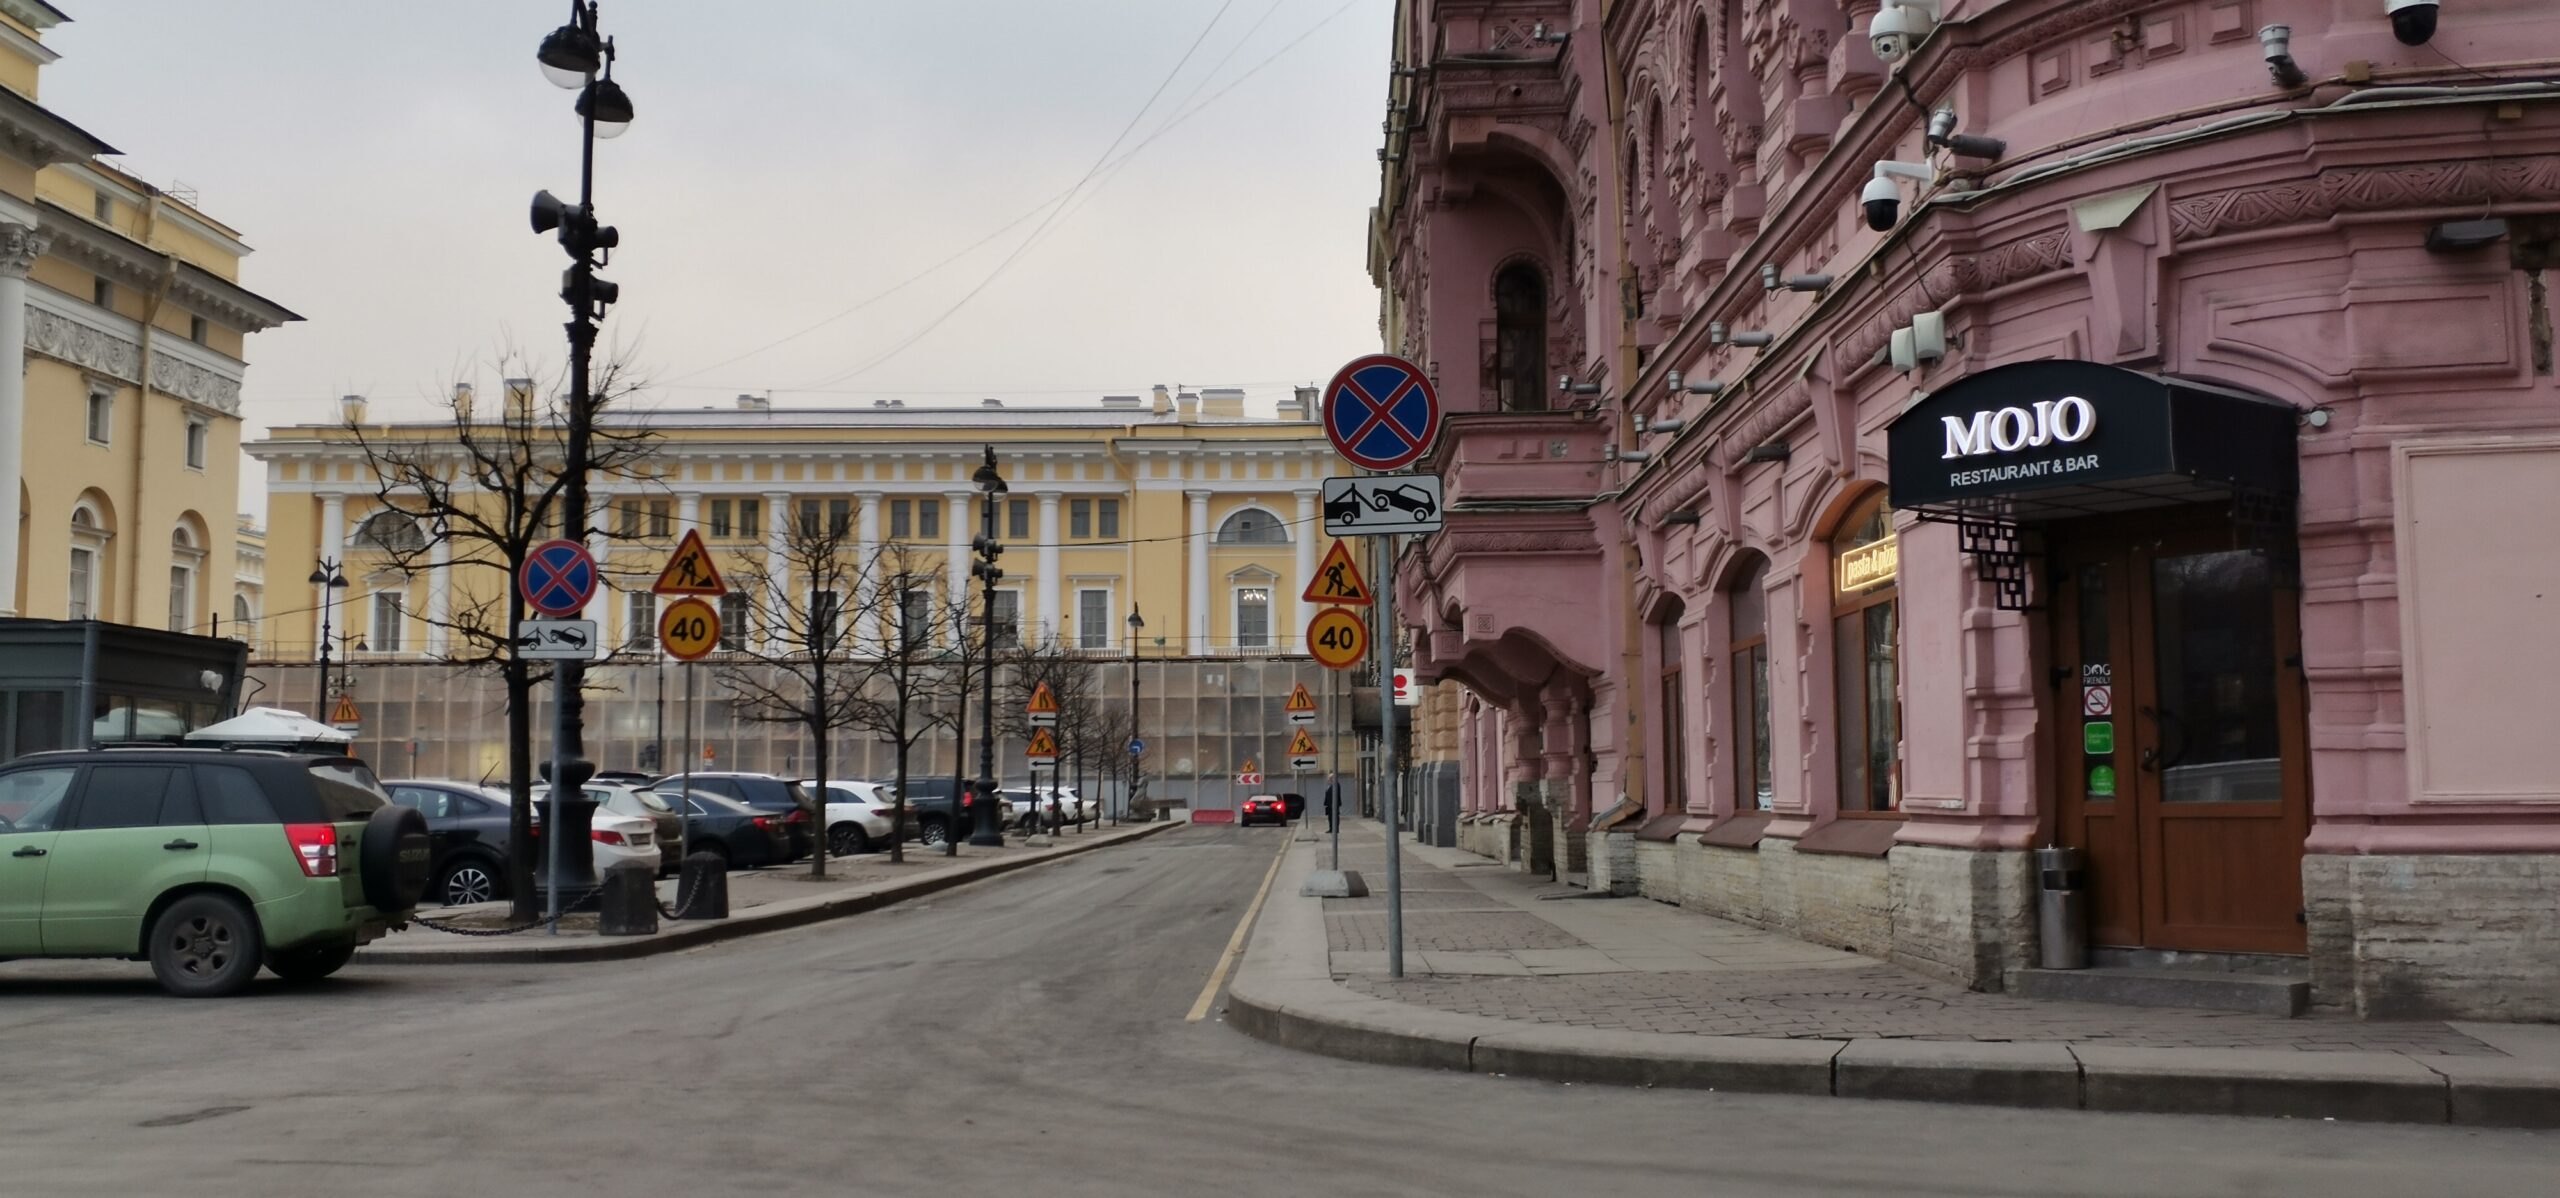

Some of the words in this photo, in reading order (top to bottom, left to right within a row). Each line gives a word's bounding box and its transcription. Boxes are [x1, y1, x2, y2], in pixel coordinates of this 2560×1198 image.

[1940, 396, 2097, 460] MOJO
[1950, 460, 2050, 487] RESTAURANT
[2052, 459, 2064, 473] &
[2065, 454, 2099, 472] BAR
[1847, 553, 1871, 585] pasta
[671, 617, 706, 642] 40
[1319, 626, 1354, 650] 40
[2083, 664, 2111, 676] DOG
